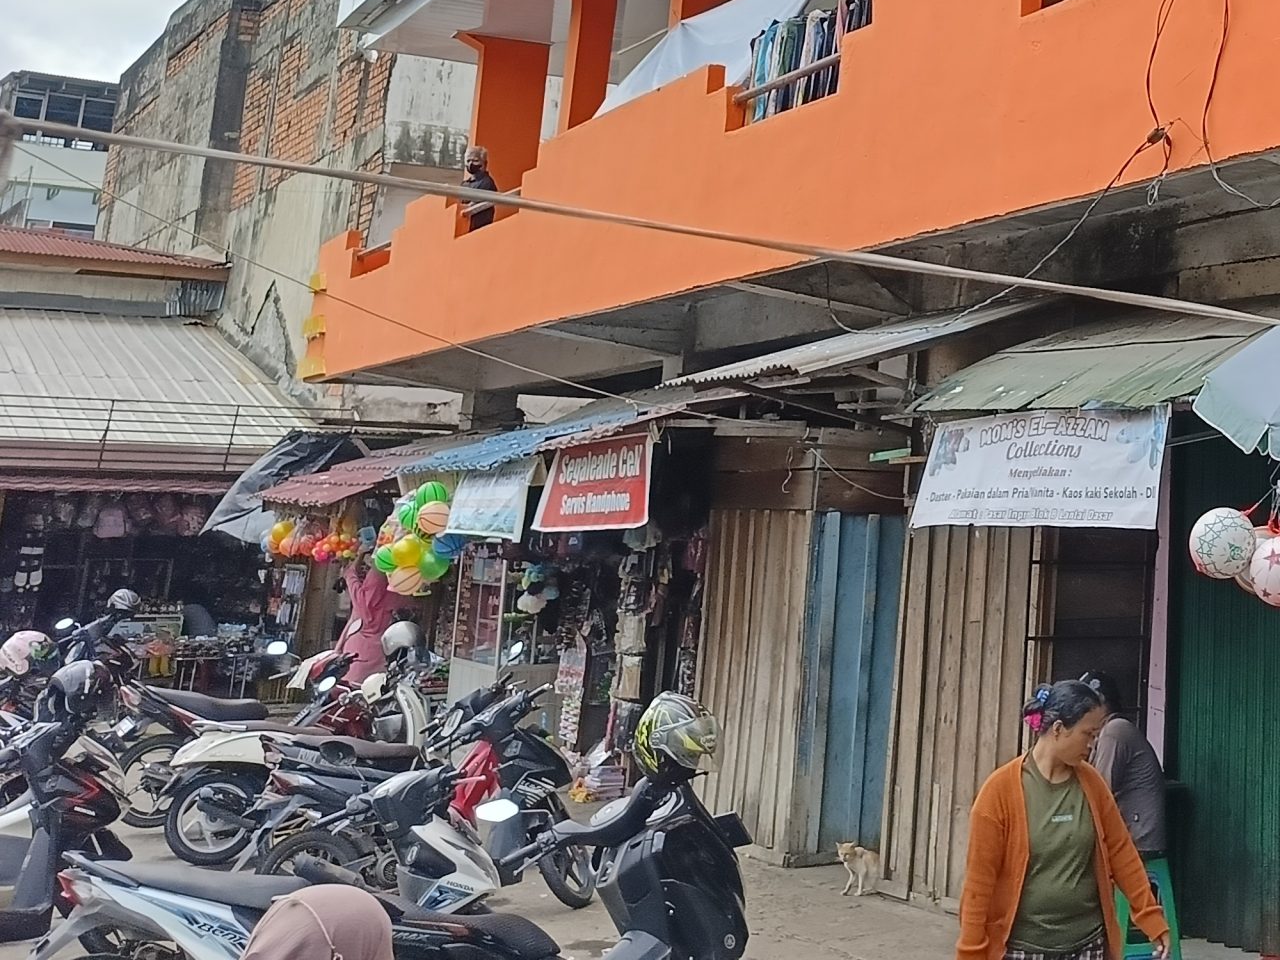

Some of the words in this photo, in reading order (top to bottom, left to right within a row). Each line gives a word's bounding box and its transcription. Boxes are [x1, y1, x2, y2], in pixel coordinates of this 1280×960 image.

[980, 419, 1026, 448] MOM'S
[1006, 439, 1082, 460] Collections
[560, 493, 585, 515] Servis
[586, 491, 631, 515] Handphone
[987, 487, 1009, 498] dalam
[1062, 487, 1082, 499] Kaos
[1084, 487, 1101, 498] kaki
[1103, 486, 1137, 499] Sekolah
[446, 879, 475, 893] HONDA
